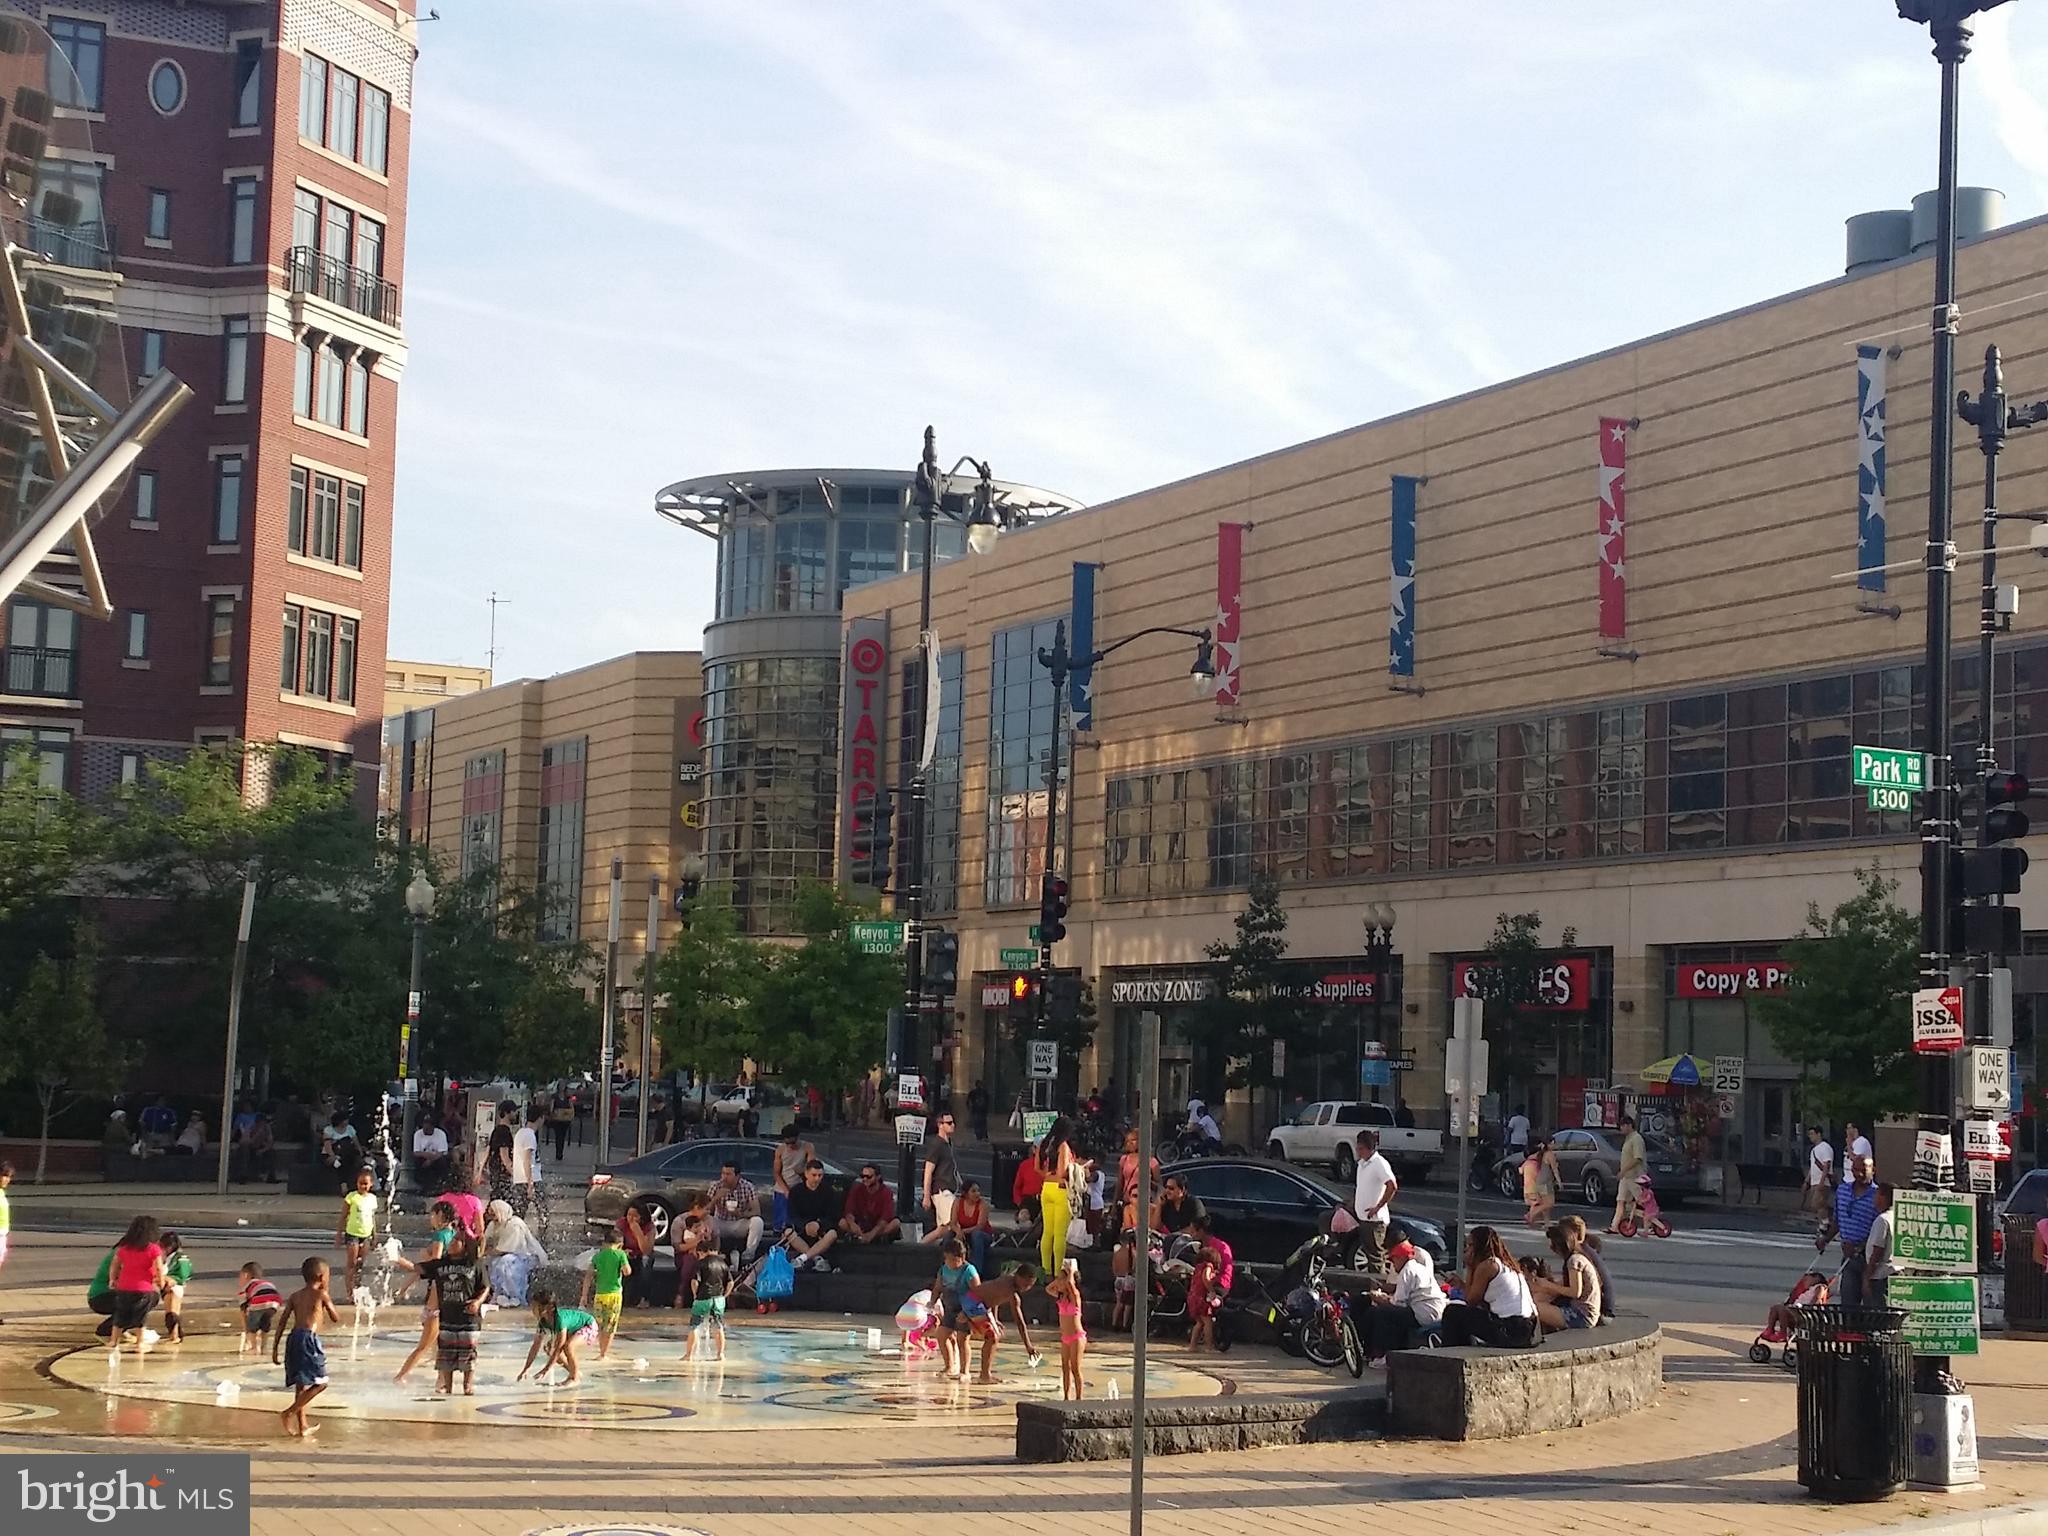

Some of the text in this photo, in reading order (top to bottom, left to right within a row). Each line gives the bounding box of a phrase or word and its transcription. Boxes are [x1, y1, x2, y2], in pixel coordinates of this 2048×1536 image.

[1861, 752, 1920, 783] Park RD
[1872, 788, 1909, 810] 1300
[854, 924, 889, 943] Kenyon
[863, 943, 892, 954] 1300
[1693, 969, 1740, 994] Copy
[1746, 968, 1759, 989] &
[1111, 979, 1203, 1002] SPORTS ZONE
[1314, 979, 1374, 1001] Supplies
[1035, 1044, 1053, 1054] ONE
[1034, 1055, 1054, 1065] WAY
[1979, 1052, 2003, 1067] ONE
[1716, 1075, 1741, 1091] 25
[1978, 1070, 2004, 1084] WAY
[1925, 1239, 1966, 1251] COUNCIL
[1908, 1314, 1972, 1323] Senator
[1922, 1328, 1937, 1337] for
[1939, 1328, 1954, 1337] the
[1924, 1340, 1941, 1350] the
